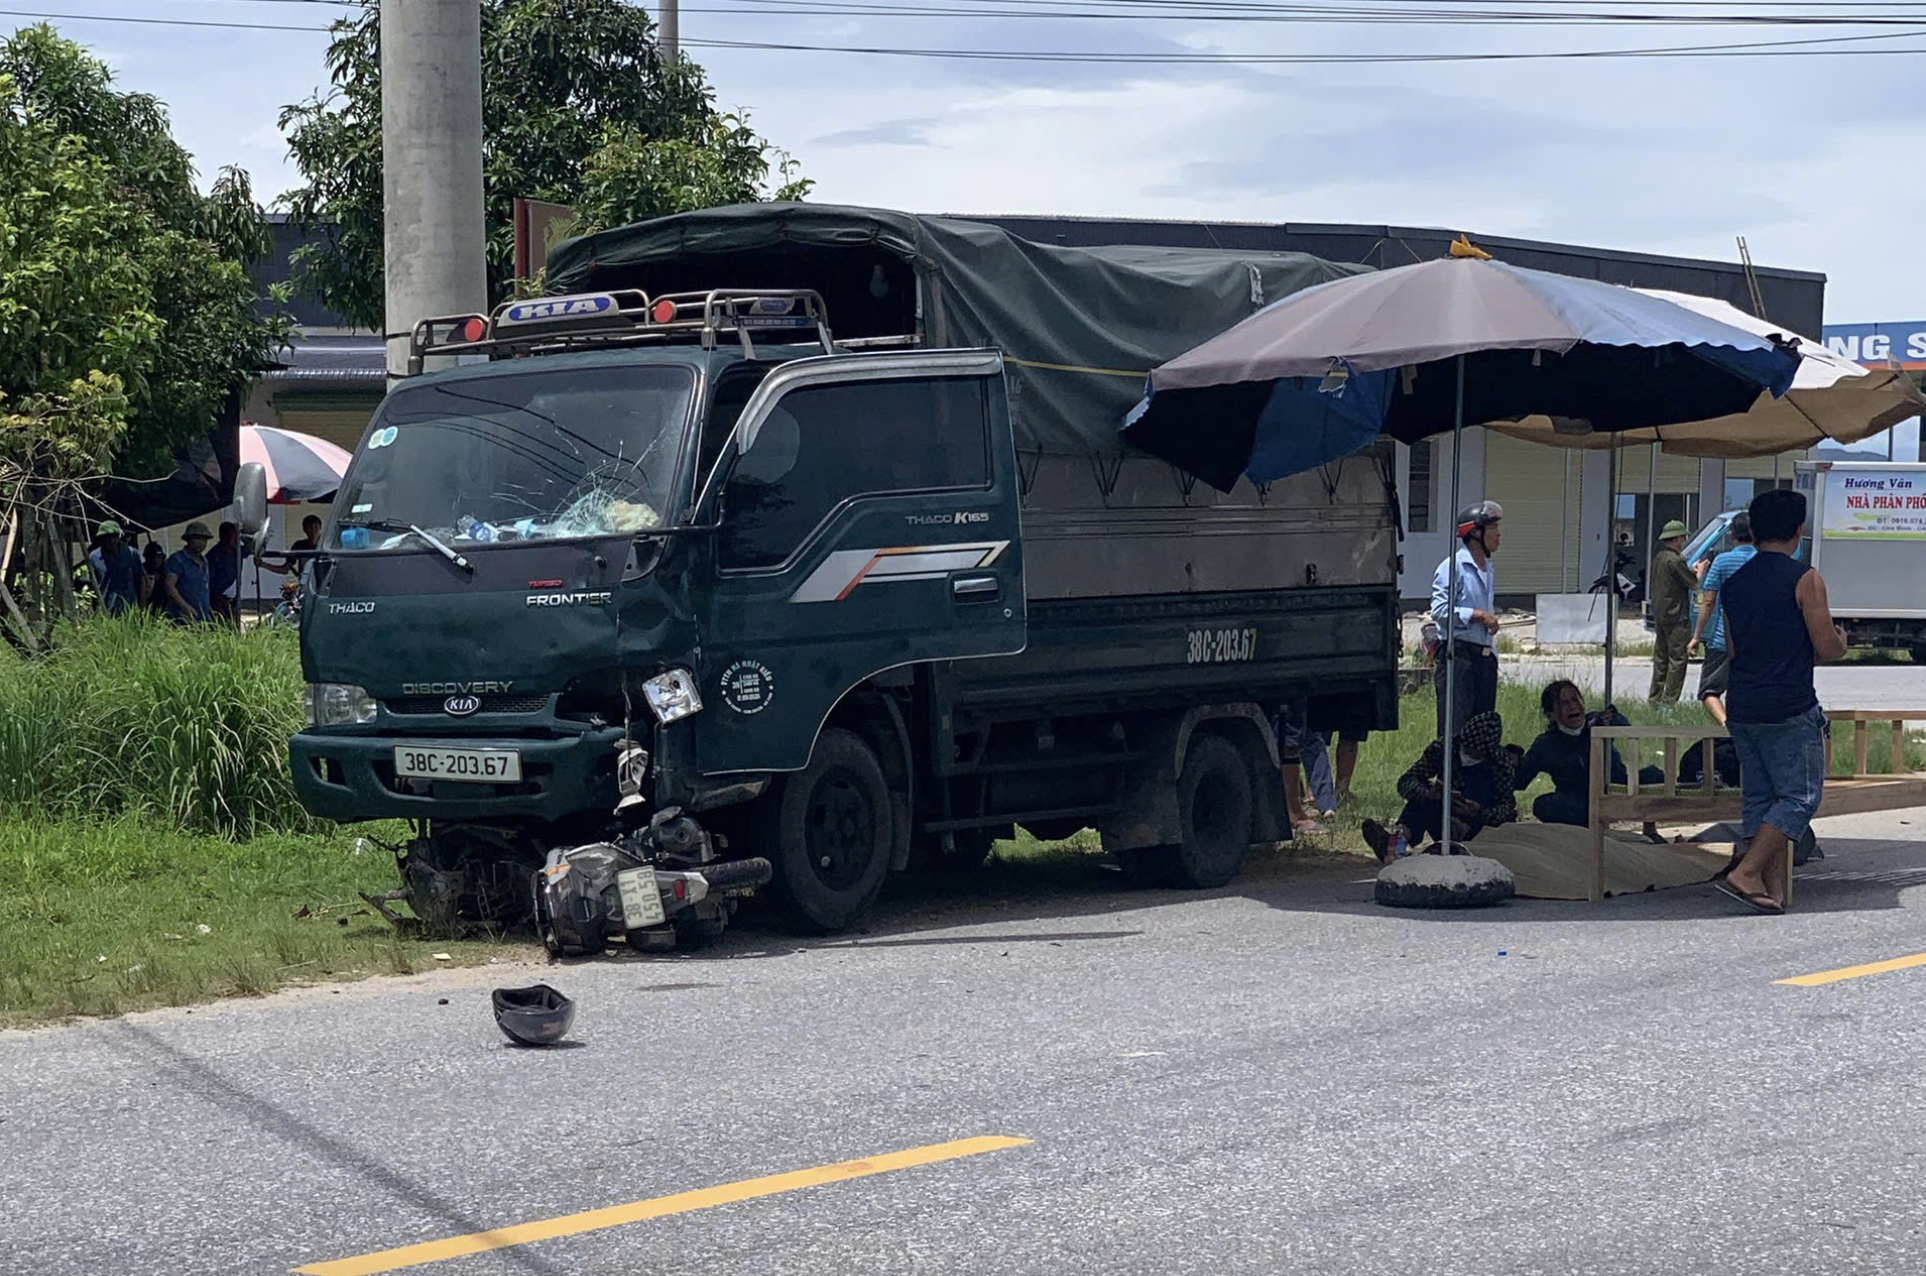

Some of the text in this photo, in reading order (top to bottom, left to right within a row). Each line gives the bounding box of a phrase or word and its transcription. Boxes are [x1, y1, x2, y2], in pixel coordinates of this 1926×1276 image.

[518, 301, 600, 319] KIA
[1822, 335, 1891, 360] NG
[1844, 478, 1912, 490] Hương Vân
[1846, 492, 1870, 508] NHÀ
[1873, 493, 1903, 509] PHÂN
[905, 511, 989, 525] THACO K165
[526, 592, 612, 606] FRONTIER
[328, 602, 375, 615] THACO
[1187, 627, 1258, 664] 38C-203.67
[402, 681, 513, 694] DISCOVERY
[405, 752, 508, 776] 38C-203.67
[637, 870, 662, 919] 450.58
